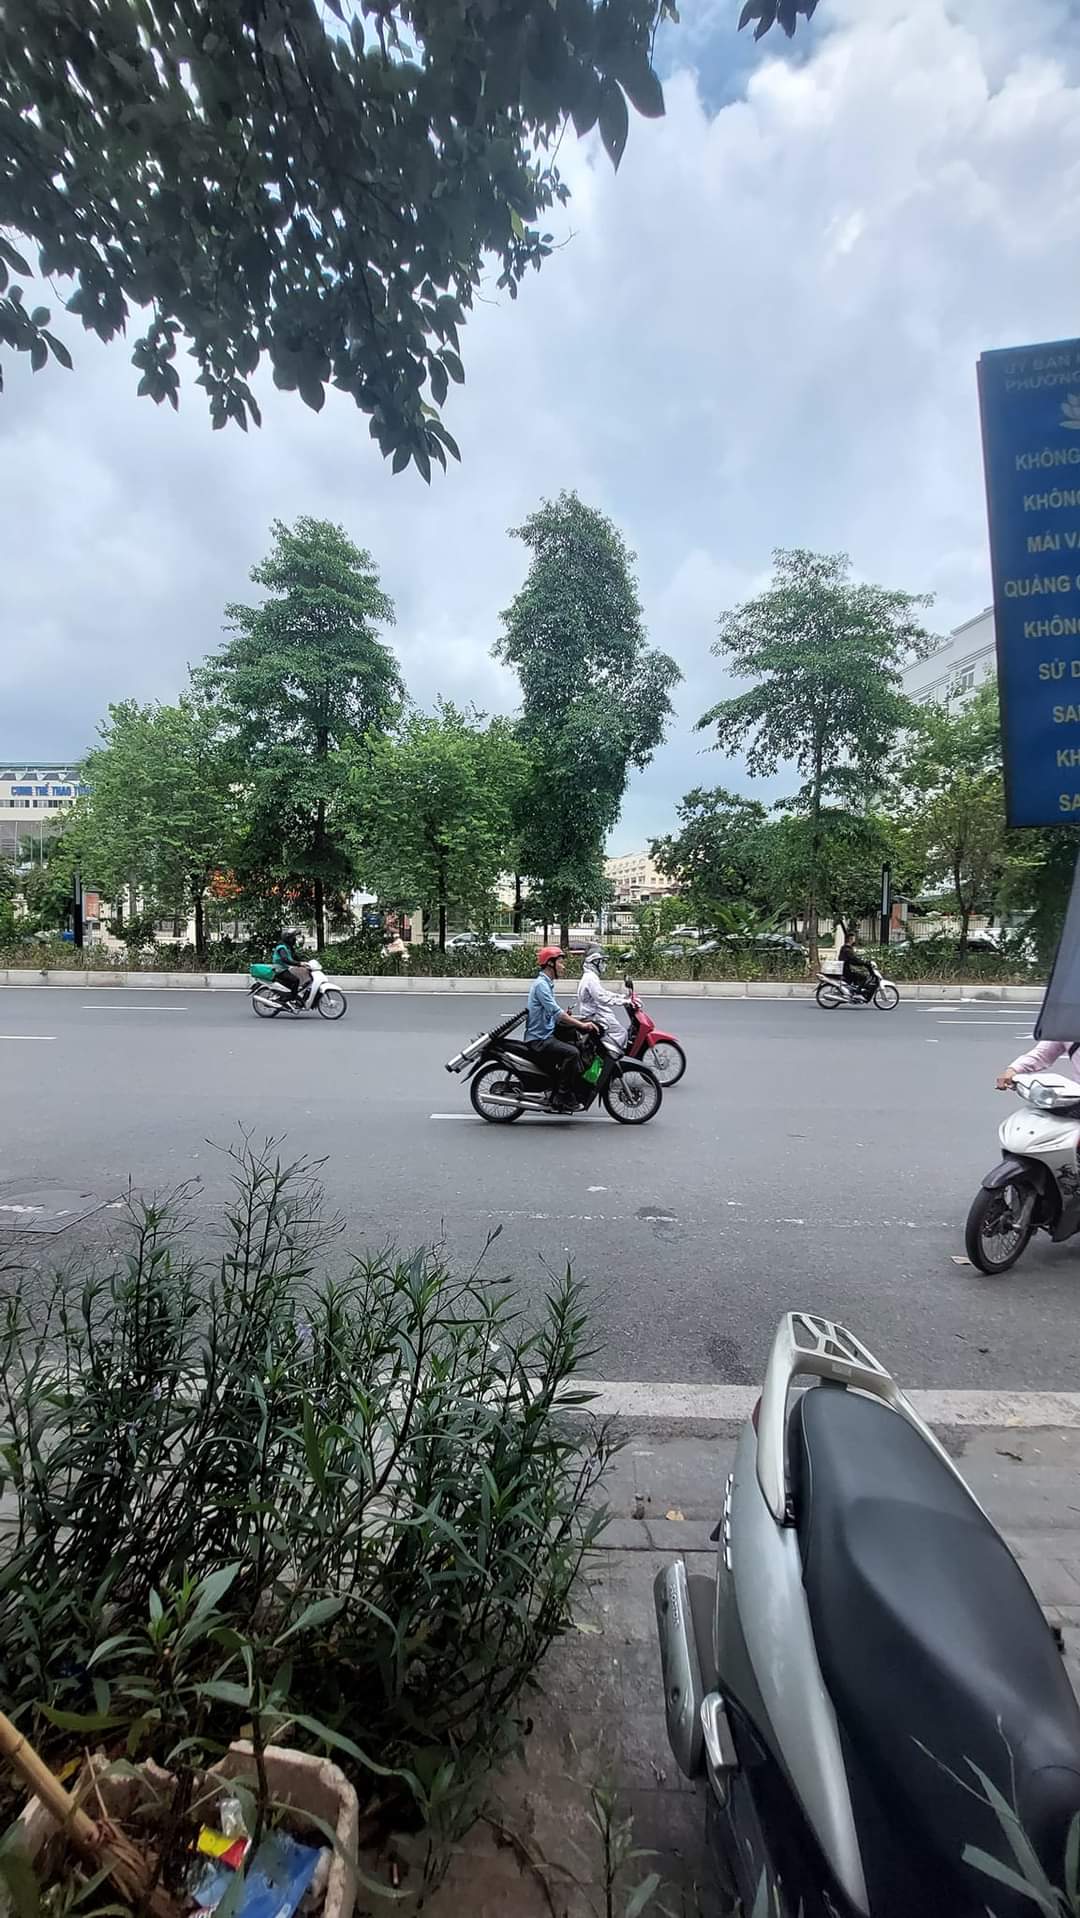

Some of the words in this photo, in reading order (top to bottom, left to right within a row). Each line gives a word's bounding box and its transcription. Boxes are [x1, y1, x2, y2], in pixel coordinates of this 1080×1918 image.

[1015, 446, 1080, 471] KHÔNG
[1023, 487, 1080, 512] KHÔN
[1027, 529, 1061, 552] MÁI
[1064, 530, 1080, 549] V
[1003, 573, 1071, 598] QUẢNG
[1023, 614, 1080, 639] KHÔN
[1038, 657, 1066, 680] SỬ
